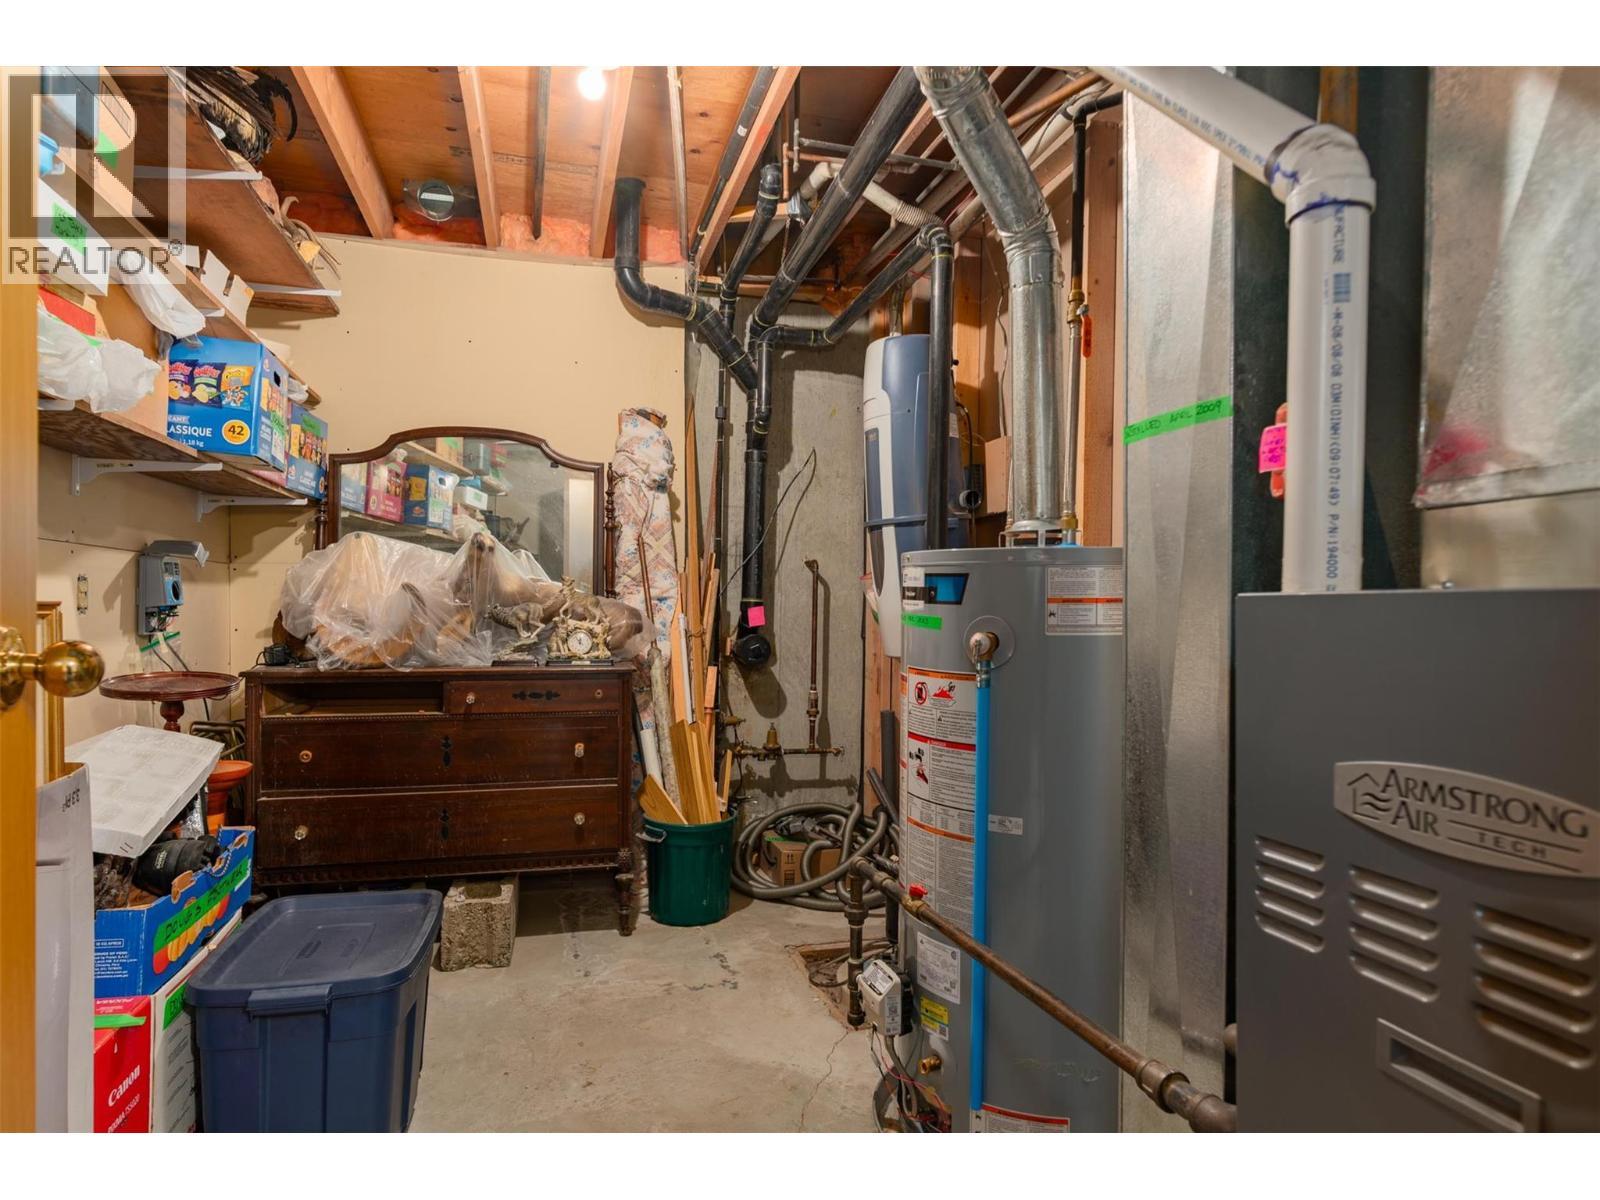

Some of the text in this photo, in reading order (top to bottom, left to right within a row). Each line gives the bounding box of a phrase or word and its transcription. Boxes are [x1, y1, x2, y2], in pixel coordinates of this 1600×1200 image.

[167, 424, 213, 437] ASSIQUE
[228, 425, 245, 436] 42
[1380, 767, 1589, 838] ARMSTRONG
[1391, 800, 1440, 837] AIR
[1478, 832, 1548, 859] TECH
[108, 1064, 141, 1107] Canon
